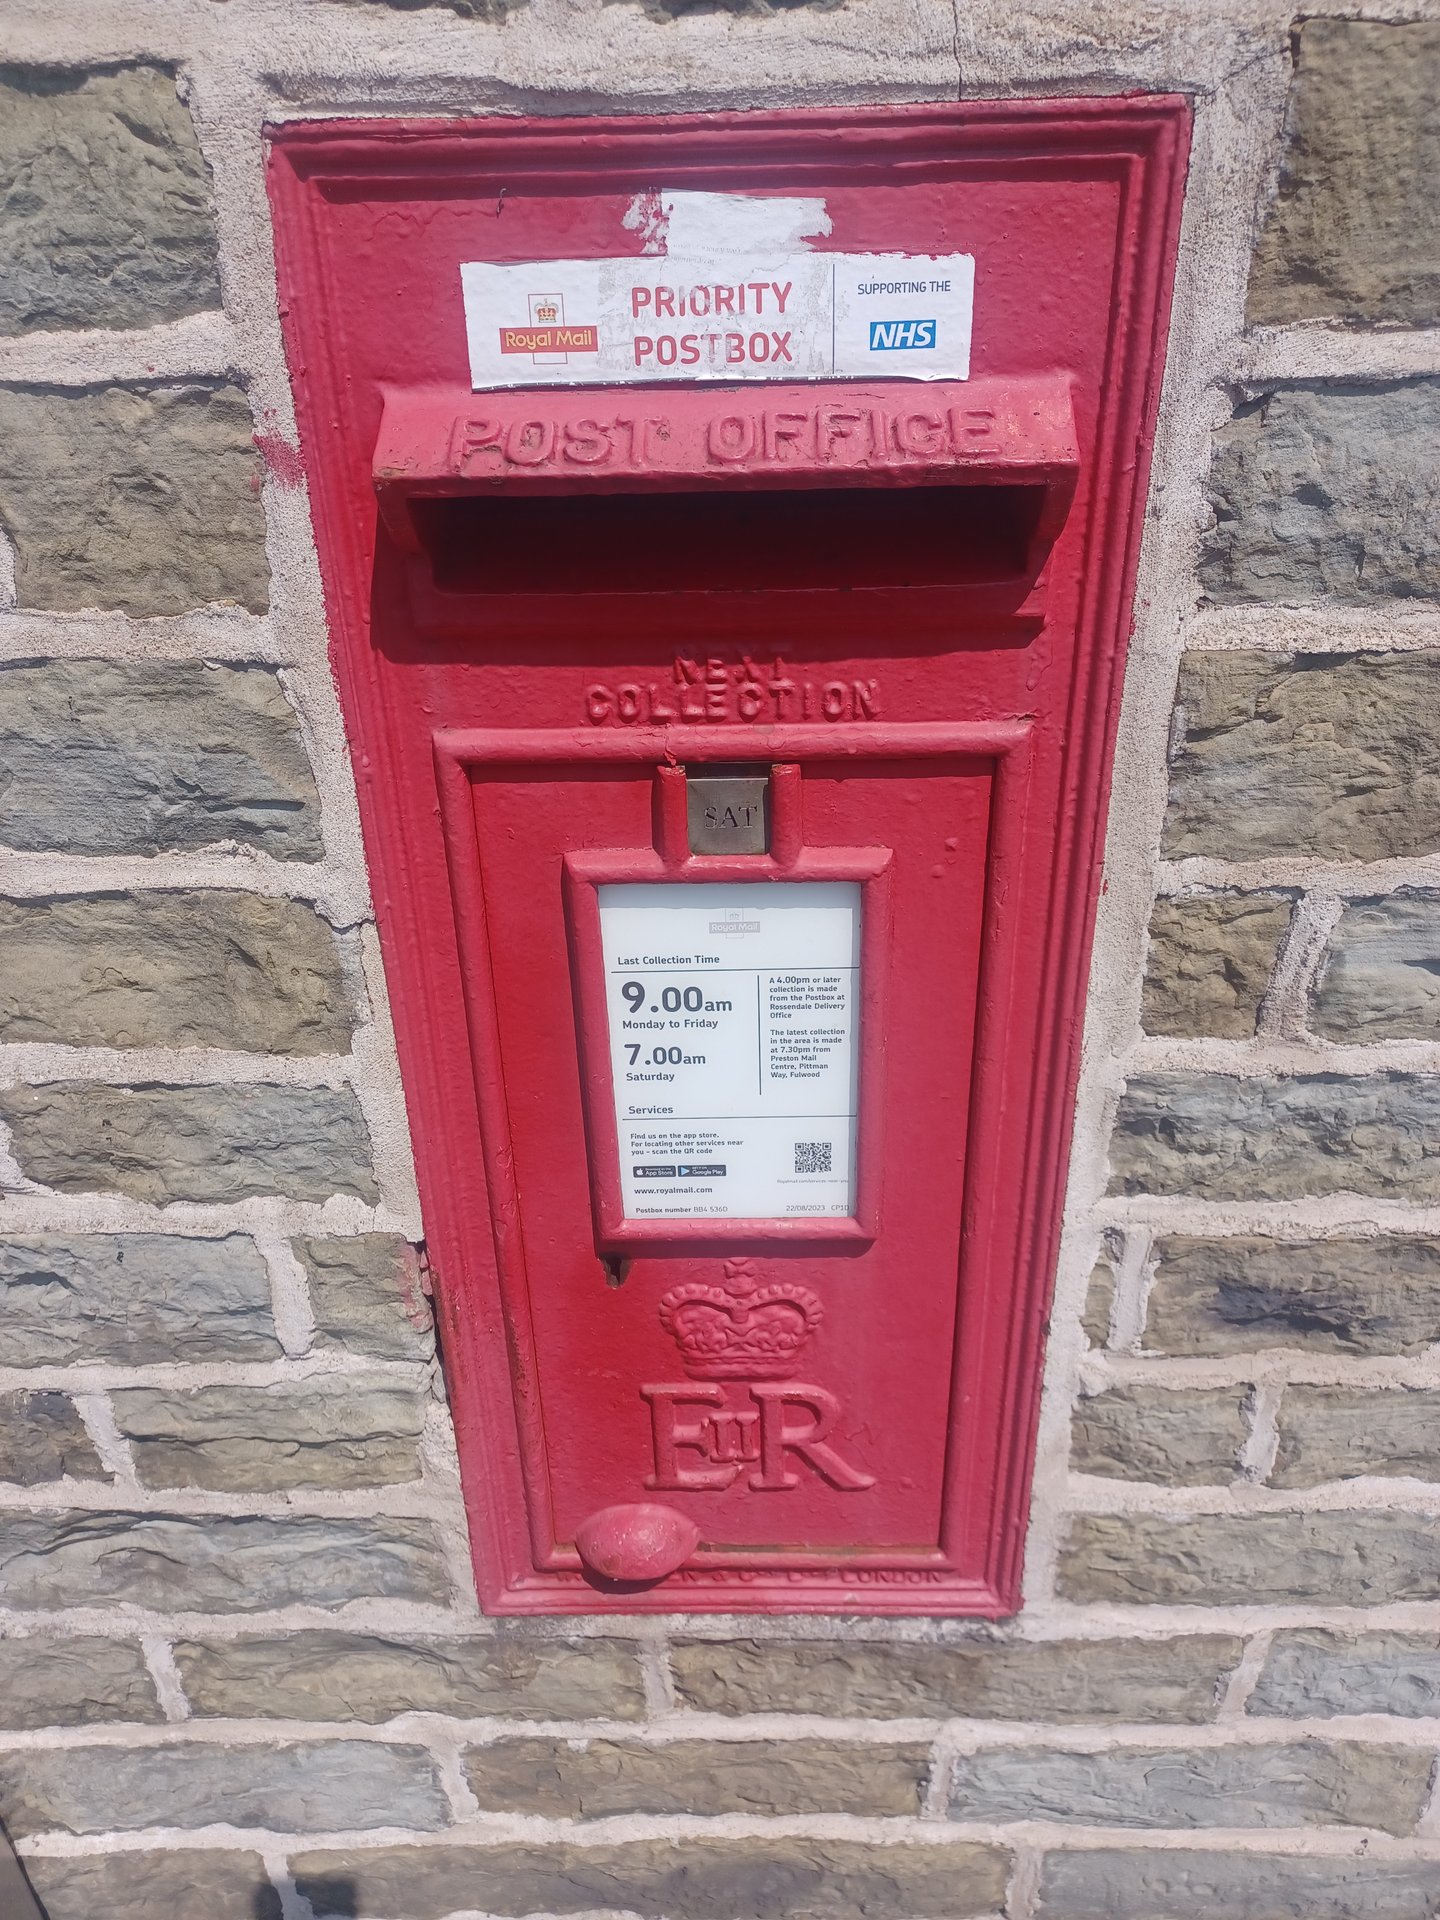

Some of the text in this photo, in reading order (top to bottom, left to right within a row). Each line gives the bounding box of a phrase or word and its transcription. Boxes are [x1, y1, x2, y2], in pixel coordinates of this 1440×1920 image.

[857, 280, 951, 296] SUPPORTING THE
[631, 282, 792, 318] PRIORITY
[505, 330, 592, 349] Royal Mail
[872, 322, 933, 349] NHS
[634, 331, 793, 367] POSTBOX
[447, 407, 1000, 470] POST OFFICE
[585, 679, 881, 725] COLLECTION
[704, 805, 757, 829] SAT
[711, 922, 758, 932] Royal Mail
[617, 954, 720, 965] Last Collection Time
[777, 976, 810, 985] 4.00pm
[769, 985, 806, 993] collection
[621, 981, 733, 1014] 9.00am
[770, 994, 788, 1002] from
[814, 1002, 845, 1010] Delivery
[770, 1011, 792, 1019] Office
[622, 1018, 719, 1031] Monday to Friday
[786, 1028, 807, 1036] latest
[624, 1043, 706, 1066] 7.00am
[780, 1046, 811, 1054] 7.30pm
[770, 1063, 797, 1071] Centre,
[626, 1072, 675, 1082] Saturday
[770, 1071, 788, 1079] Way,
[628, 1105, 674, 1115] Services
[644, 1140, 673, 1148] locating
[634, 1187, 713, 1195] www.royalmail.com
